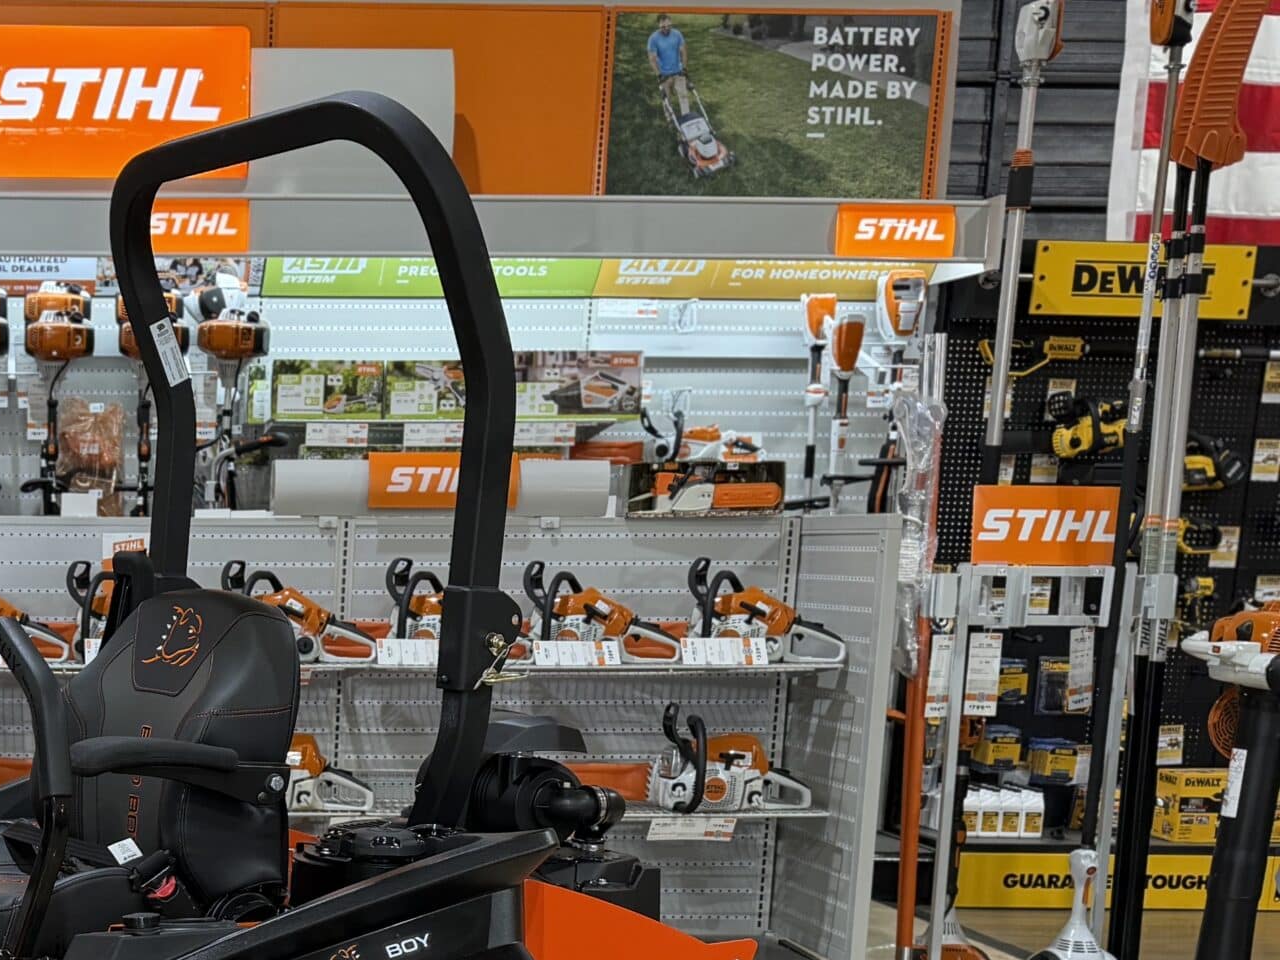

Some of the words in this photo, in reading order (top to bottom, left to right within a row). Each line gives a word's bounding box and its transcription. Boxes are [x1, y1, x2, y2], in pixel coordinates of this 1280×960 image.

[813, 27, 920, 46] BATTERY
[811, 53, 906, 73] POWER.
[809, 80, 878, 99] MADE
[886, 81, 917, 99] BY
[807, 106, 883, 125] STIHL.
[150, 212, 238, 235] STIHL
[854, 218, 945, 241] STIHL
[11, 265, 60, 274] DEALERS
[280, 275, 336, 283] SYSTEM
[731, 269, 763, 279] FOR
[615, 276, 672, 285] SYSTEM
[386, 467, 459, 493] STI
[977, 509, 1116, 543] STIHL
[1140, 619, 1151, 648] TIHL
[385, 933, 430, 958] BOY
